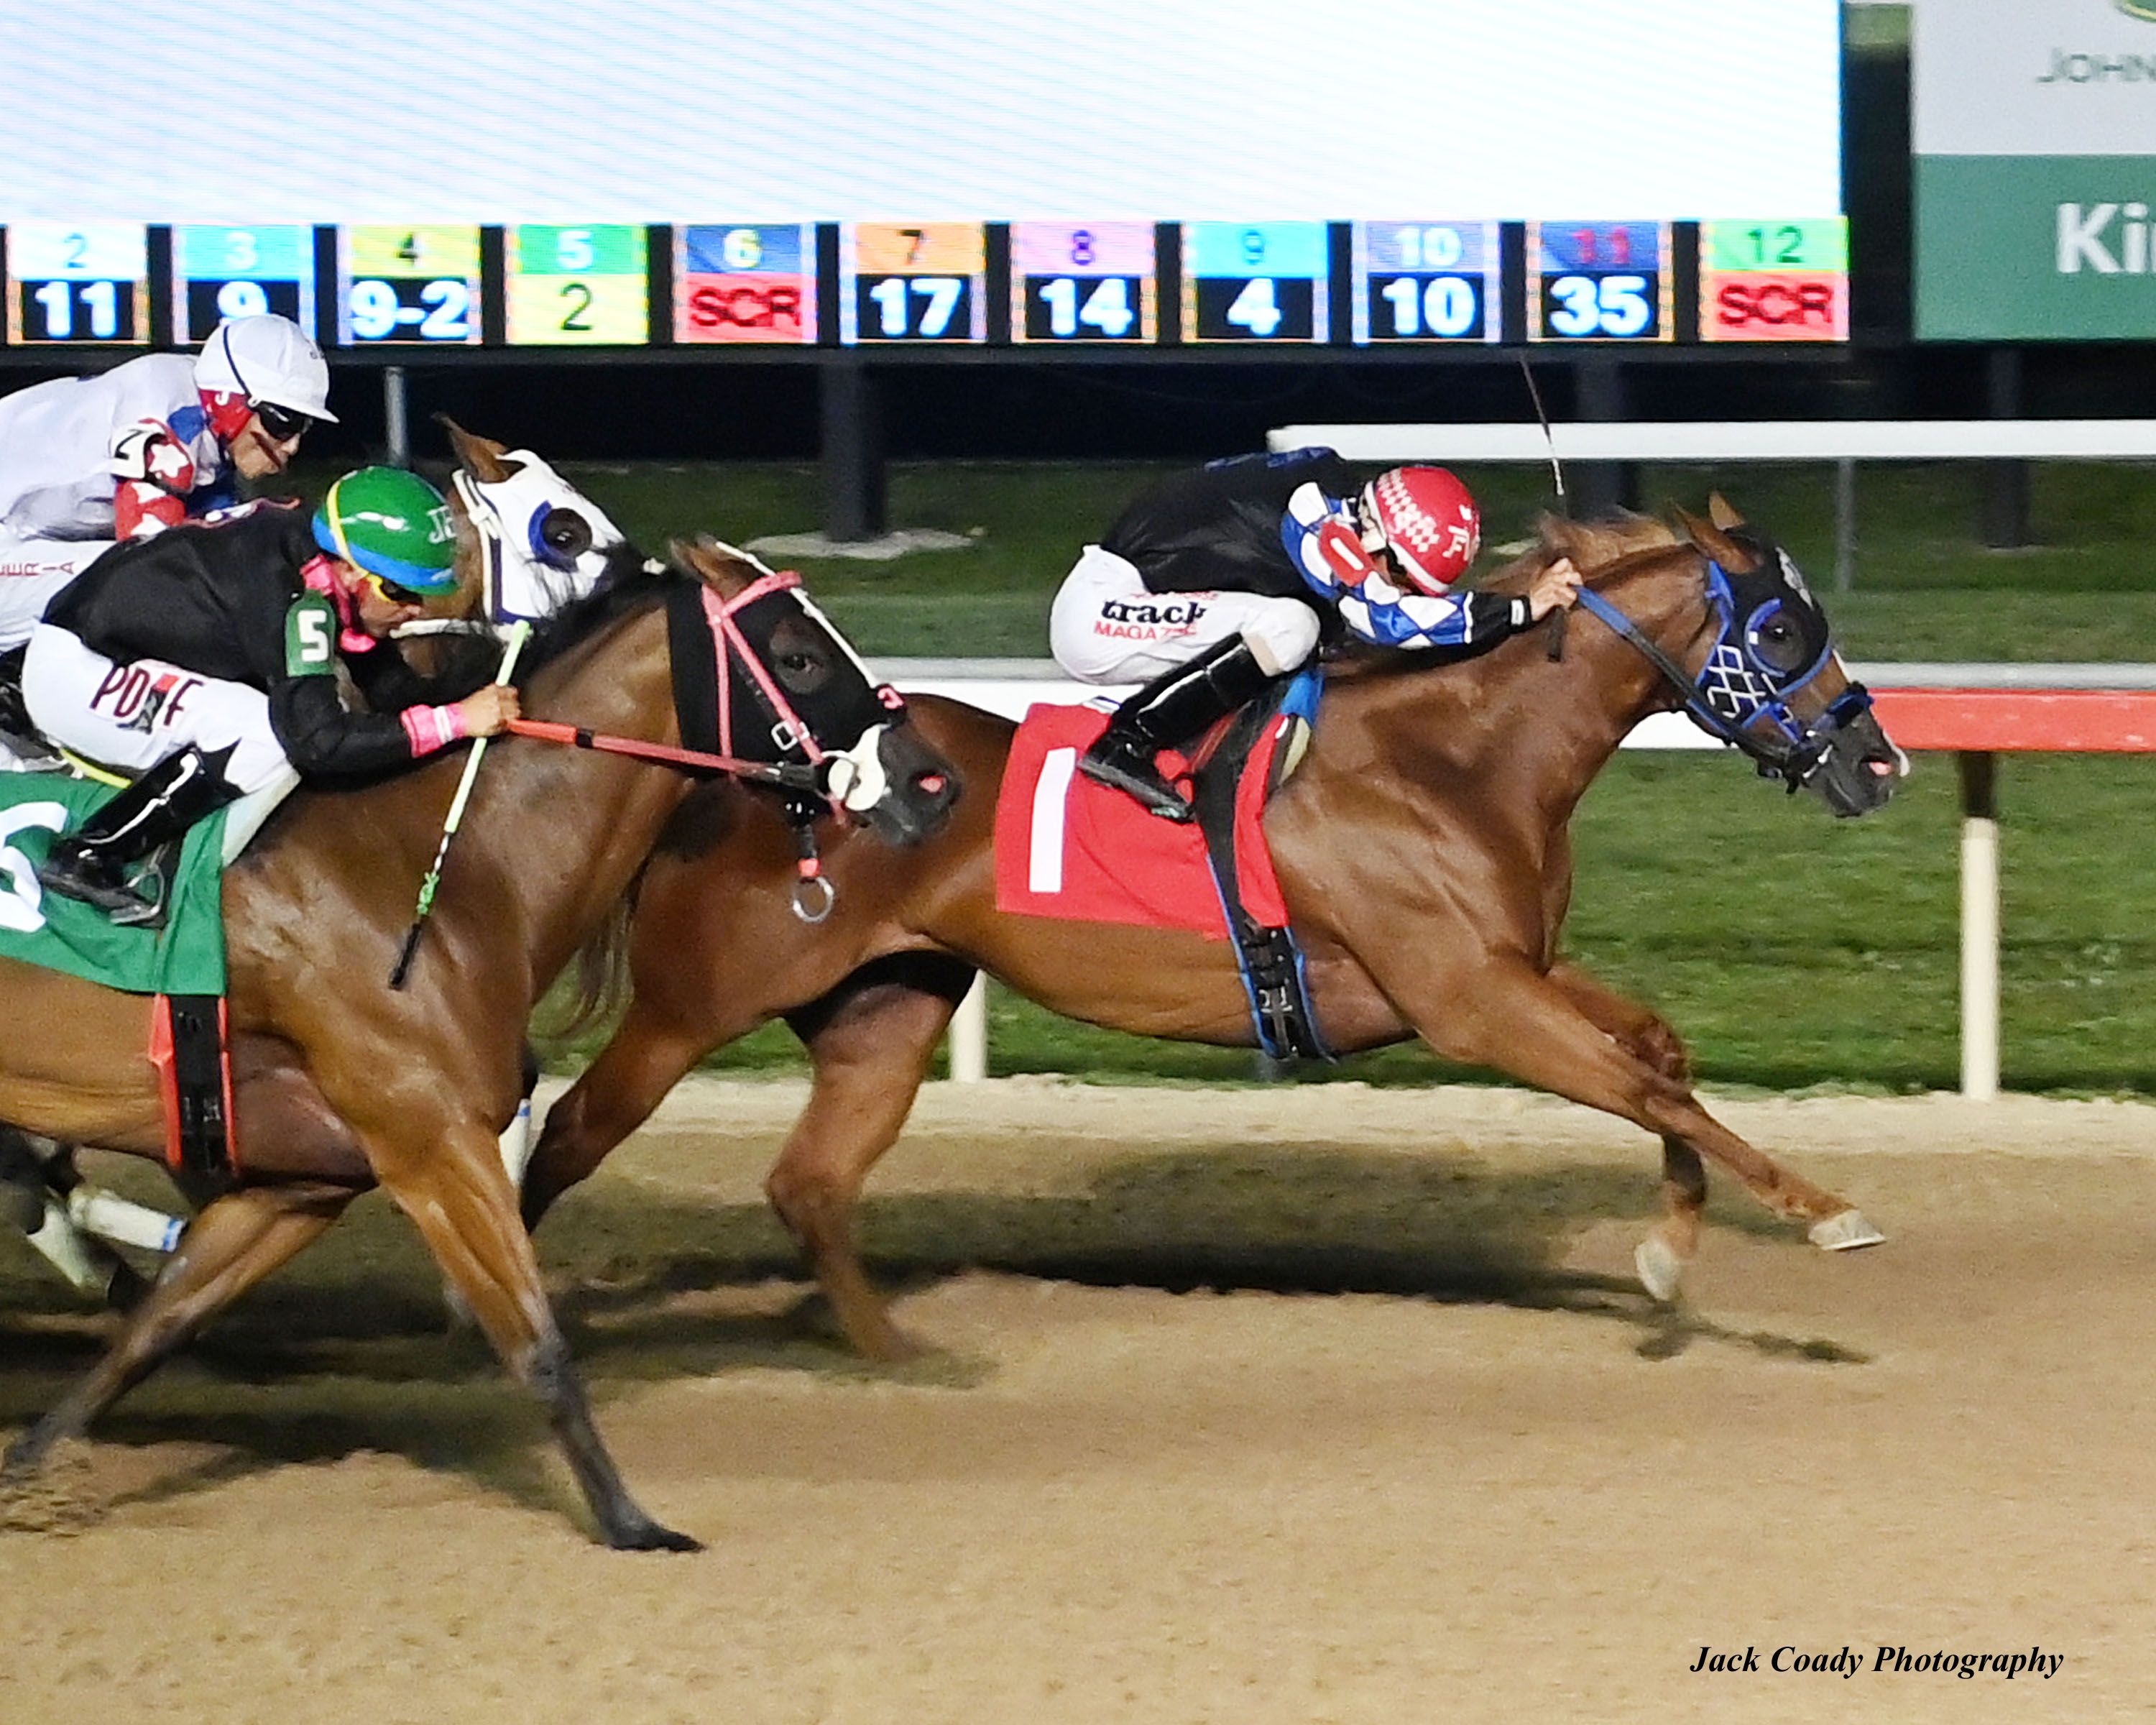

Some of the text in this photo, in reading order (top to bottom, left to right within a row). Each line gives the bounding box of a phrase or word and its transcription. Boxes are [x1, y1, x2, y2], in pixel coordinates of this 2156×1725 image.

[63, 226, 1803, 271] 2 3 4 5 6 7 8 9 10 11 12
[2057, 202, 2156, 273] Ki
[35, 275, 1833, 339] 11 9 9-2 2 SCR 17 14 4 10 35 SCR
[1330, 537, 1365, 571] 1
[298, 610, 328, 661] 5
[1029, 746, 1077, 893] 1
